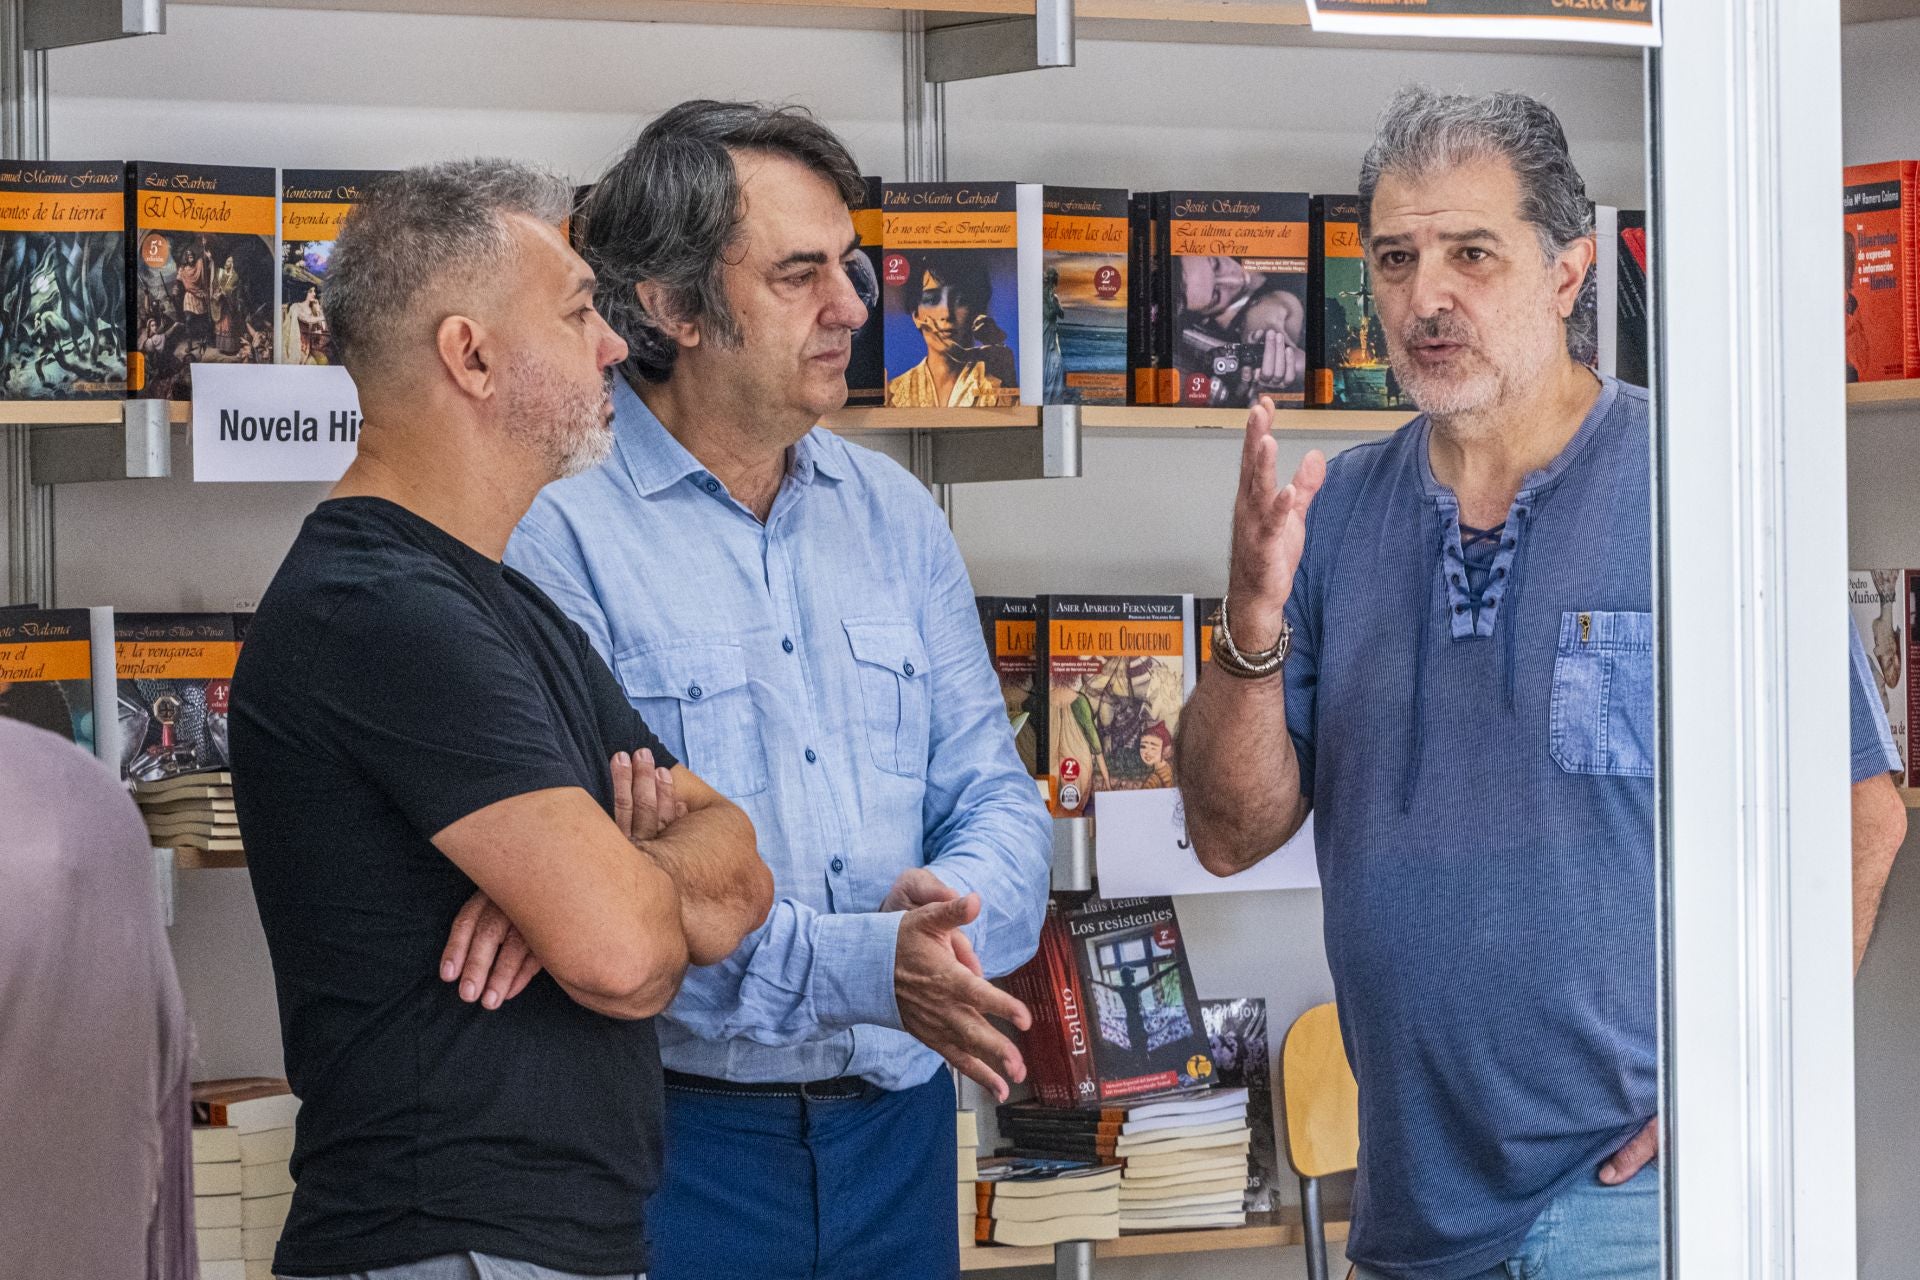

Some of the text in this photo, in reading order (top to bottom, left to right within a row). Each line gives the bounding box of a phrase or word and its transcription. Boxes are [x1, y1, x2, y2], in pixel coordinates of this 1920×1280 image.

[23, 169, 68, 184] Marina
[70, 170, 118, 188] Franco
[883, 190, 910, 205] Pablo
[32, 202, 48, 220] de
[51, 202, 65, 220] la
[68, 205, 107, 220] tierra
[144, 196, 231, 228] El Visigodo
[1174, 199, 1209, 217] Jesús
[288, 212, 330, 228] leyenda
[885, 217, 899, 234] Yo
[933, 221, 952, 234] La
[955, 221, 1012, 237] Implorante
[1060, 222, 1083, 240] sobre
[1085, 223, 1099, 241] las
[1101, 224, 1123, 242] olas
[1176, 223, 1292, 238] La última canción de
[149, 240, 163, 256] 5ª
[1175, 239, 1249, 255] Alice Wren
[889, 258, 903, 273] 2ª
[1101, 270, 1115, 284] 2ª
[1191, 377, 1205, 392] 3ª
[220, 409, 364, 442] Novela Hi
[1002, 602, 1028, 613] ASIER
[1056, 602, 1175, 614] ASIER APARICIO FERNÁNDEZ
[1059, 624, 1073, 650] LA
[15, 645, 28, 661] el
[132, 643, 143, 657] la
[147, 647, 206, 663] venganza
[115, 660, 166, 678] templario
[214, 686, 229, 700] 4ª
[1083, 899, 1107, 914] Luis
[1070, 908, 1173, 936] Los resistentes
[1079, 1081, 1096, 1094] 20
